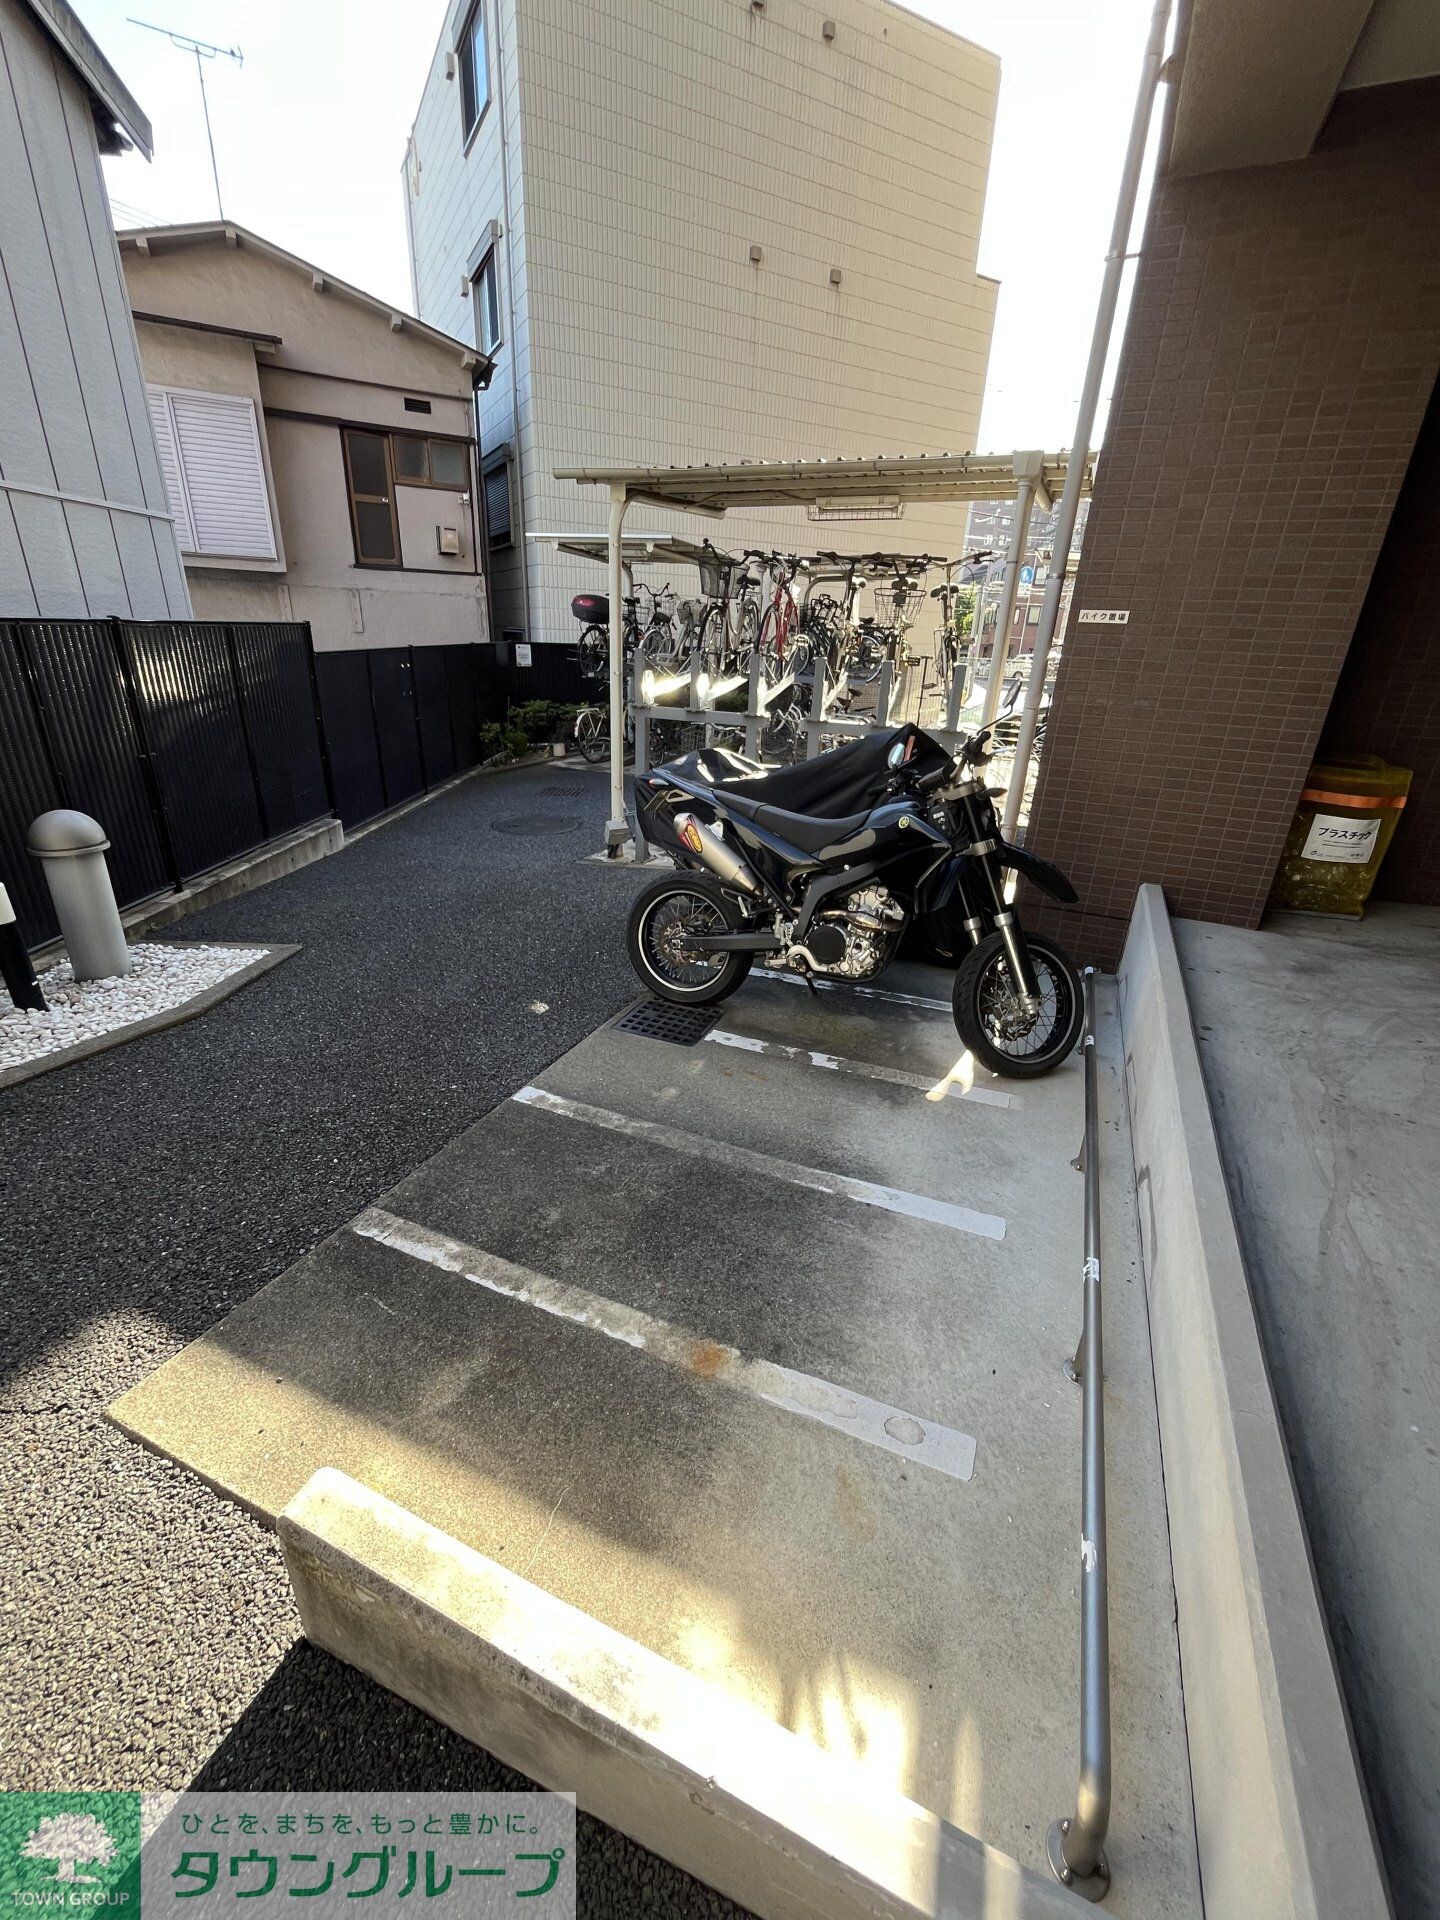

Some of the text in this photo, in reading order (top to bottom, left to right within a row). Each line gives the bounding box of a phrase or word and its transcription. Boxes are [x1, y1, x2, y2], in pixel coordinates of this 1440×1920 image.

[1081, 613, 1126, 621] バイク置場
[1318, 827, 1371, 840] プラスチック
